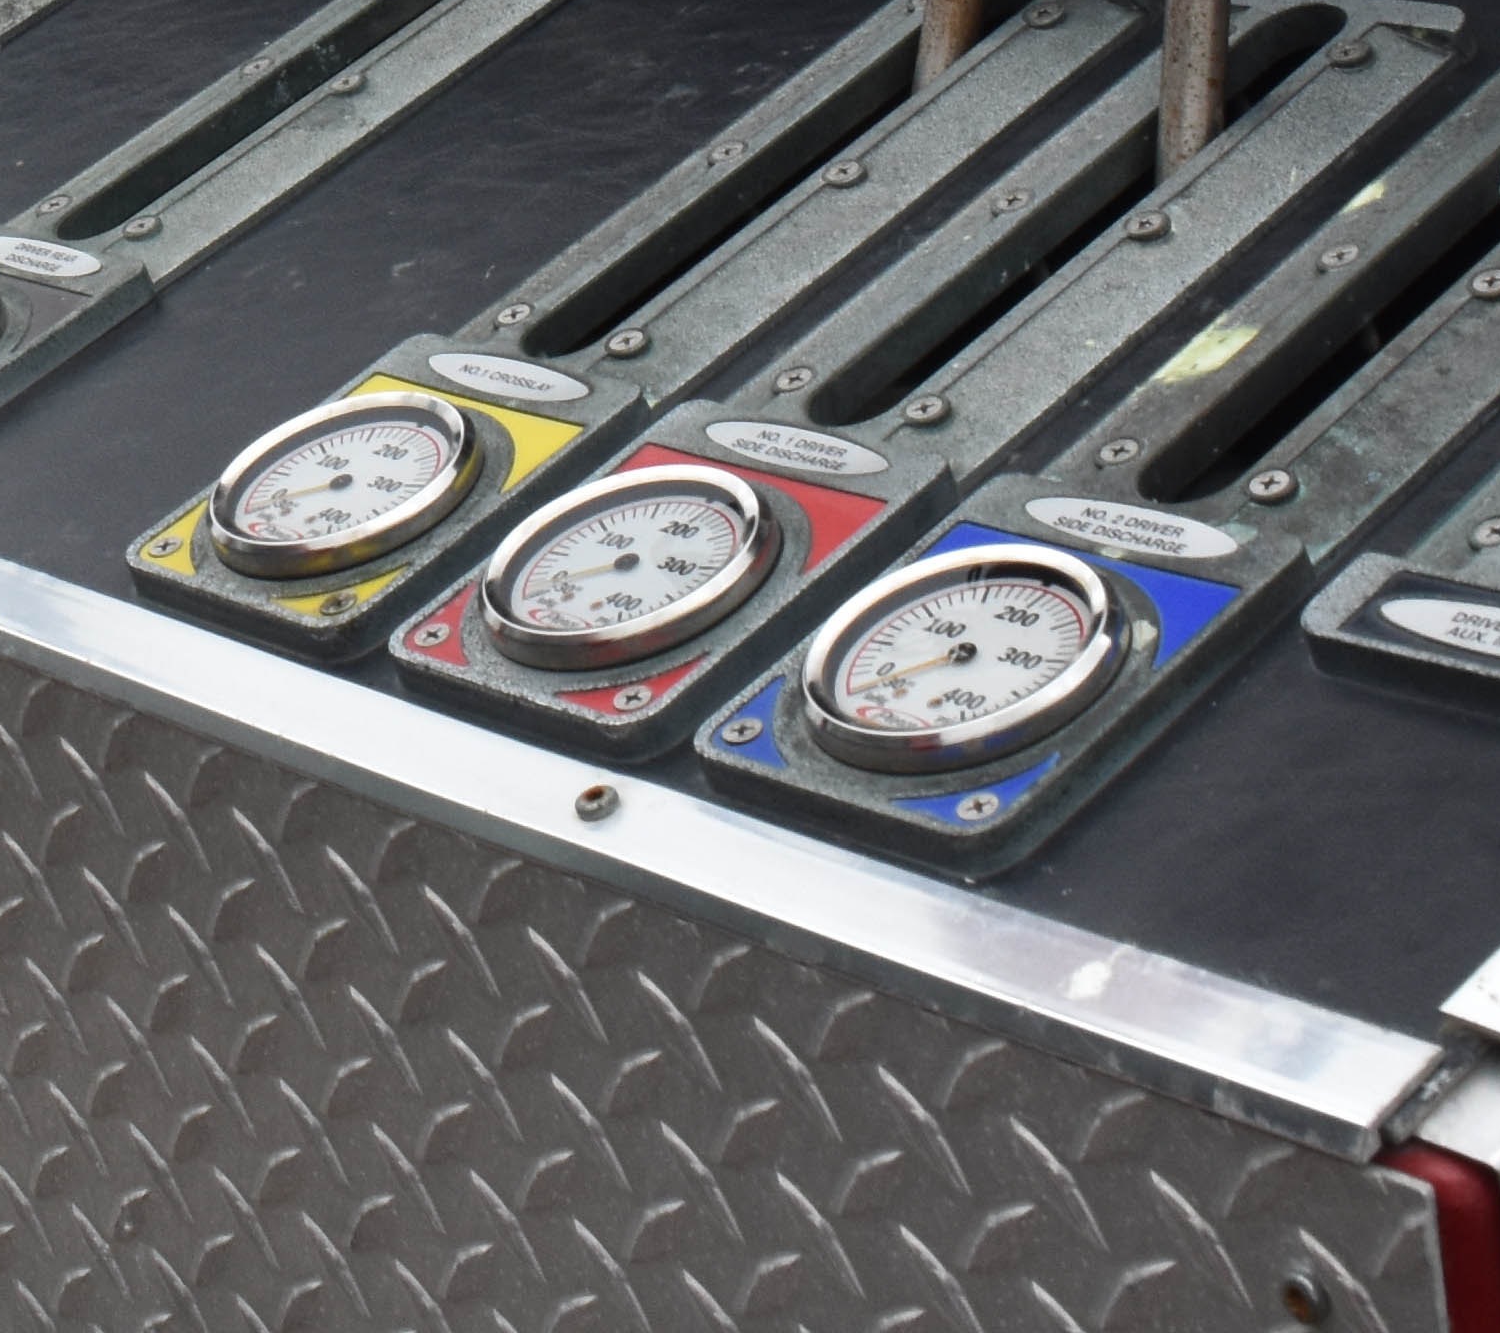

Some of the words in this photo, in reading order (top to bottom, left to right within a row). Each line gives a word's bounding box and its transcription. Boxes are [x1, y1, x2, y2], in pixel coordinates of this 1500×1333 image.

[373, 443, 408, 460] 200
[732, 438, 766, 452] SIDE
[765, 446, 847, 470] DISCHARGE
[795, 439, 848, 457] DRIVER
[315, 454, 349, 470] 100
[367, 476, 402, 492] 300
[318, 507, 351, 524] 400
[659, 520, 699, 539] 200
[1053, 516, 1092, 532] SIDE
[1092, 524, 1187, 553] DISCHARGE
[1112, 514, 1124, 524] 2
[1124, 517, 1184, 537] DRIVER
[597, 532, 634, 550] 100
[657, 556, 697, 576] 300
[604, 592, 642, 611] 400
[993, 605, 1040, 627] 200
[923, 618, 966, 638] 100
[997, 646, 1043, 670] 300
[876, 662, 896, 676] 0
[942, 687, 986, 710] 400
